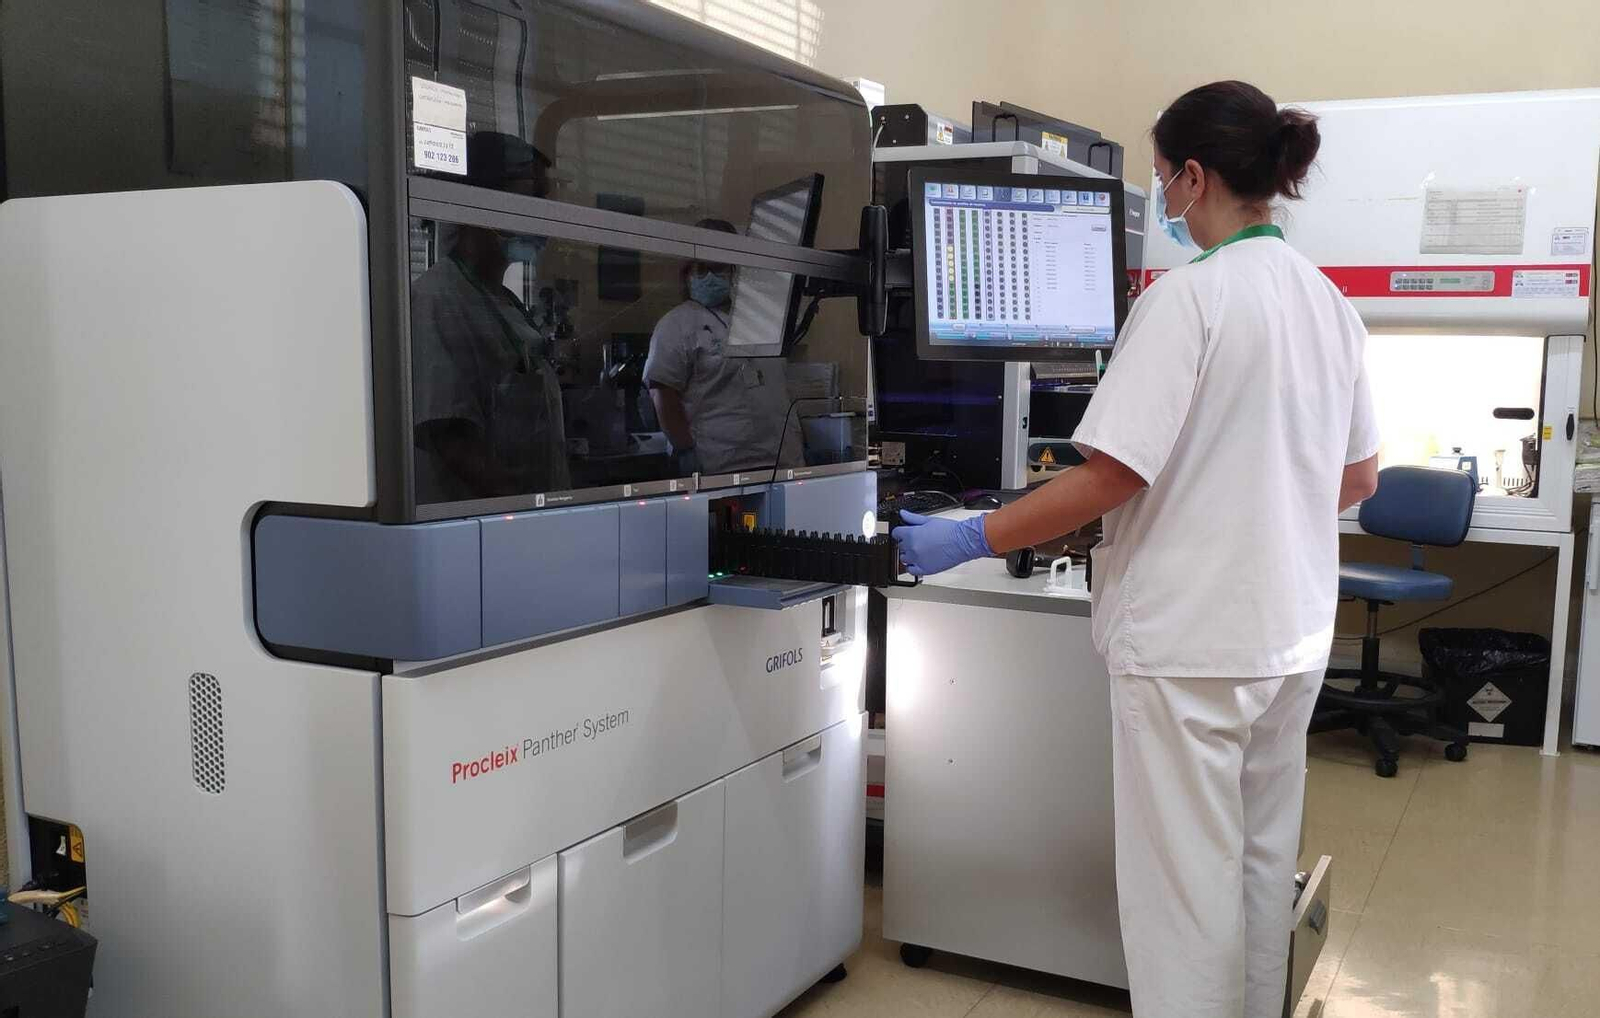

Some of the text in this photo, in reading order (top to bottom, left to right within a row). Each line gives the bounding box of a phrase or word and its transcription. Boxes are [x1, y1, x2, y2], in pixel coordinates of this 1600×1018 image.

[424, 150, 435, 160] 902
[436, 152, 447, 162] 123
[766, 647, 803, 673] GRIFOLS
[452, 709, 629, 784] Procleix Panther System
